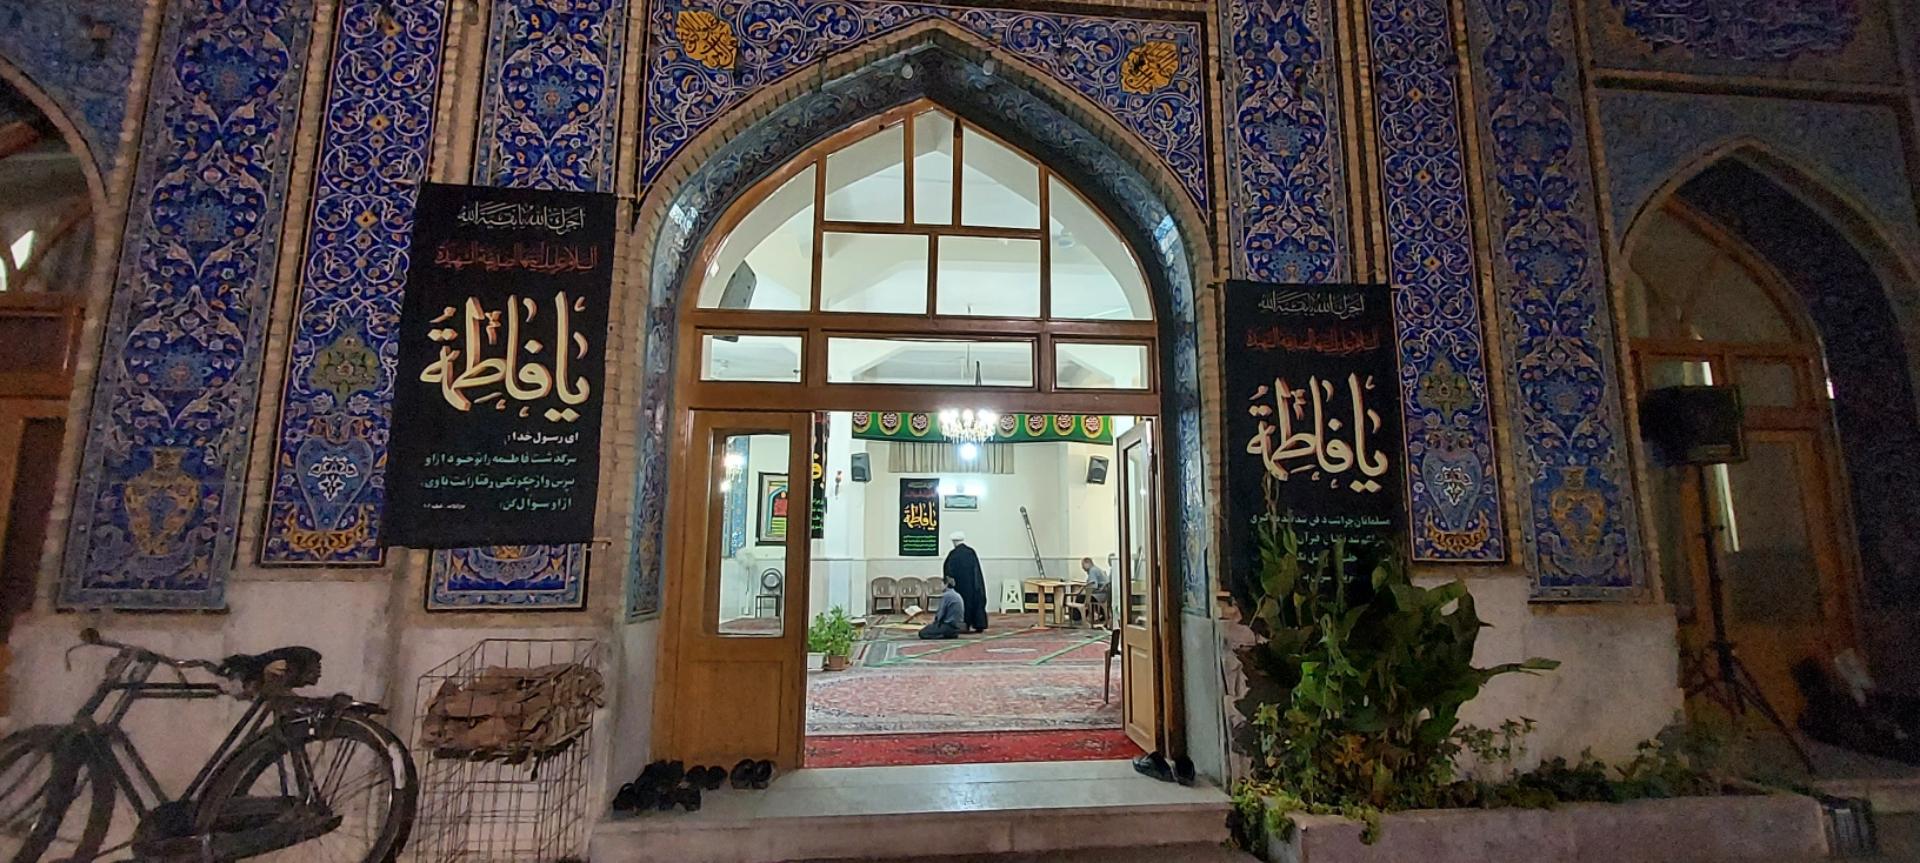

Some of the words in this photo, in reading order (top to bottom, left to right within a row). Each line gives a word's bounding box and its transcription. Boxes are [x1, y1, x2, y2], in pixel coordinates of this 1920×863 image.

[532, 431, 563, 445] رسول
[564, 431, 579, 444] ای
[446, 454, 474, 467] خود
[483, 453, 491, 466] را
[492, 452, 529, 463] فاطمه
[495, 475, 535, 492] چگونگی
[533, 474, 545, 488] از
[550, 498, 561, 511] او
[561, 497, 572, 511] از
[1353, 514, 1391, 529] مسلمانان
